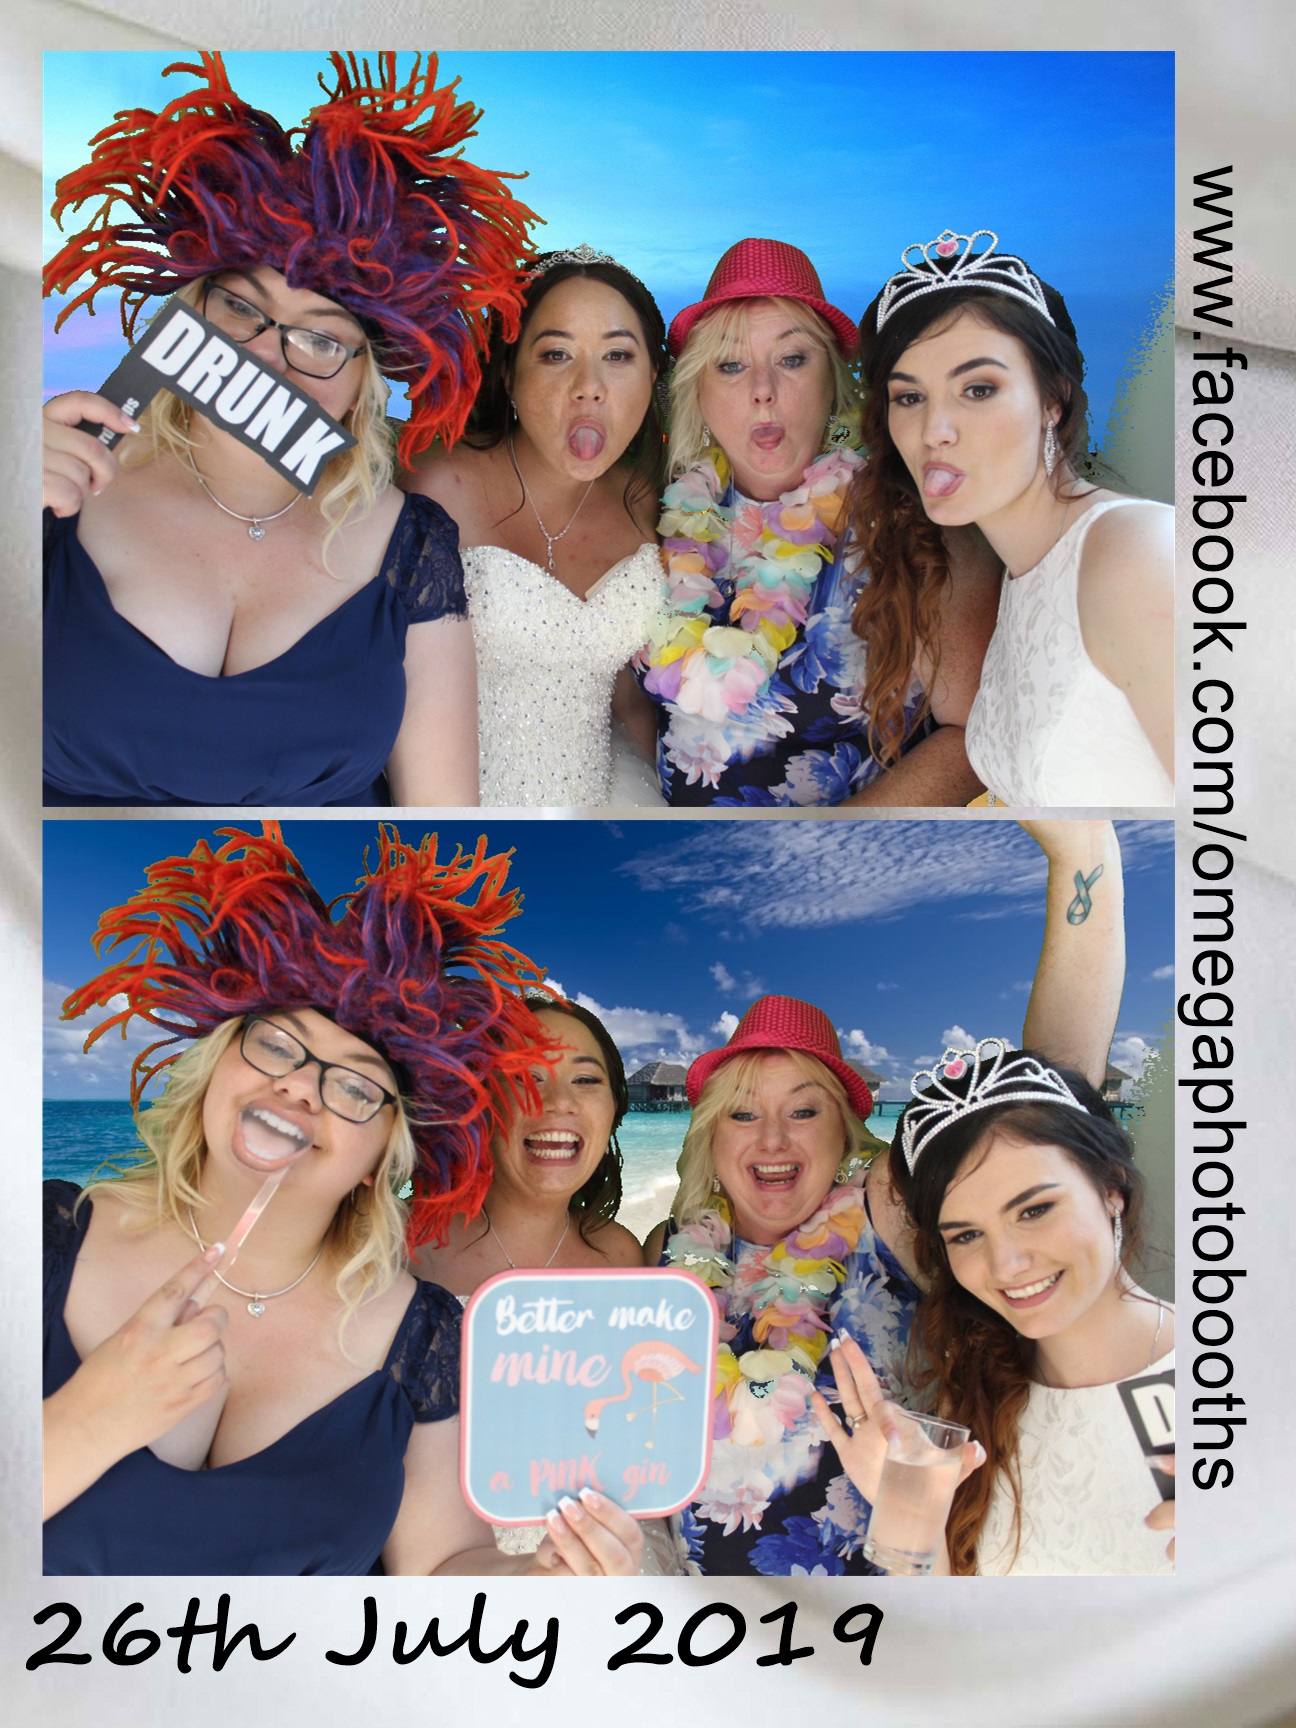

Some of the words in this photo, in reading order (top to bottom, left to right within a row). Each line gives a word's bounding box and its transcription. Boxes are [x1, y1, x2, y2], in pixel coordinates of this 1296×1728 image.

[141, 309, 346, 486] DRUNK
[495, 1294, 594, 1336] Better
[608, 1298, 696, 1331] make
[489, 1344, 612, 1387] mine
[489, 1470, 516, 1493] a
[621, 1458, 671, 1502] gin
